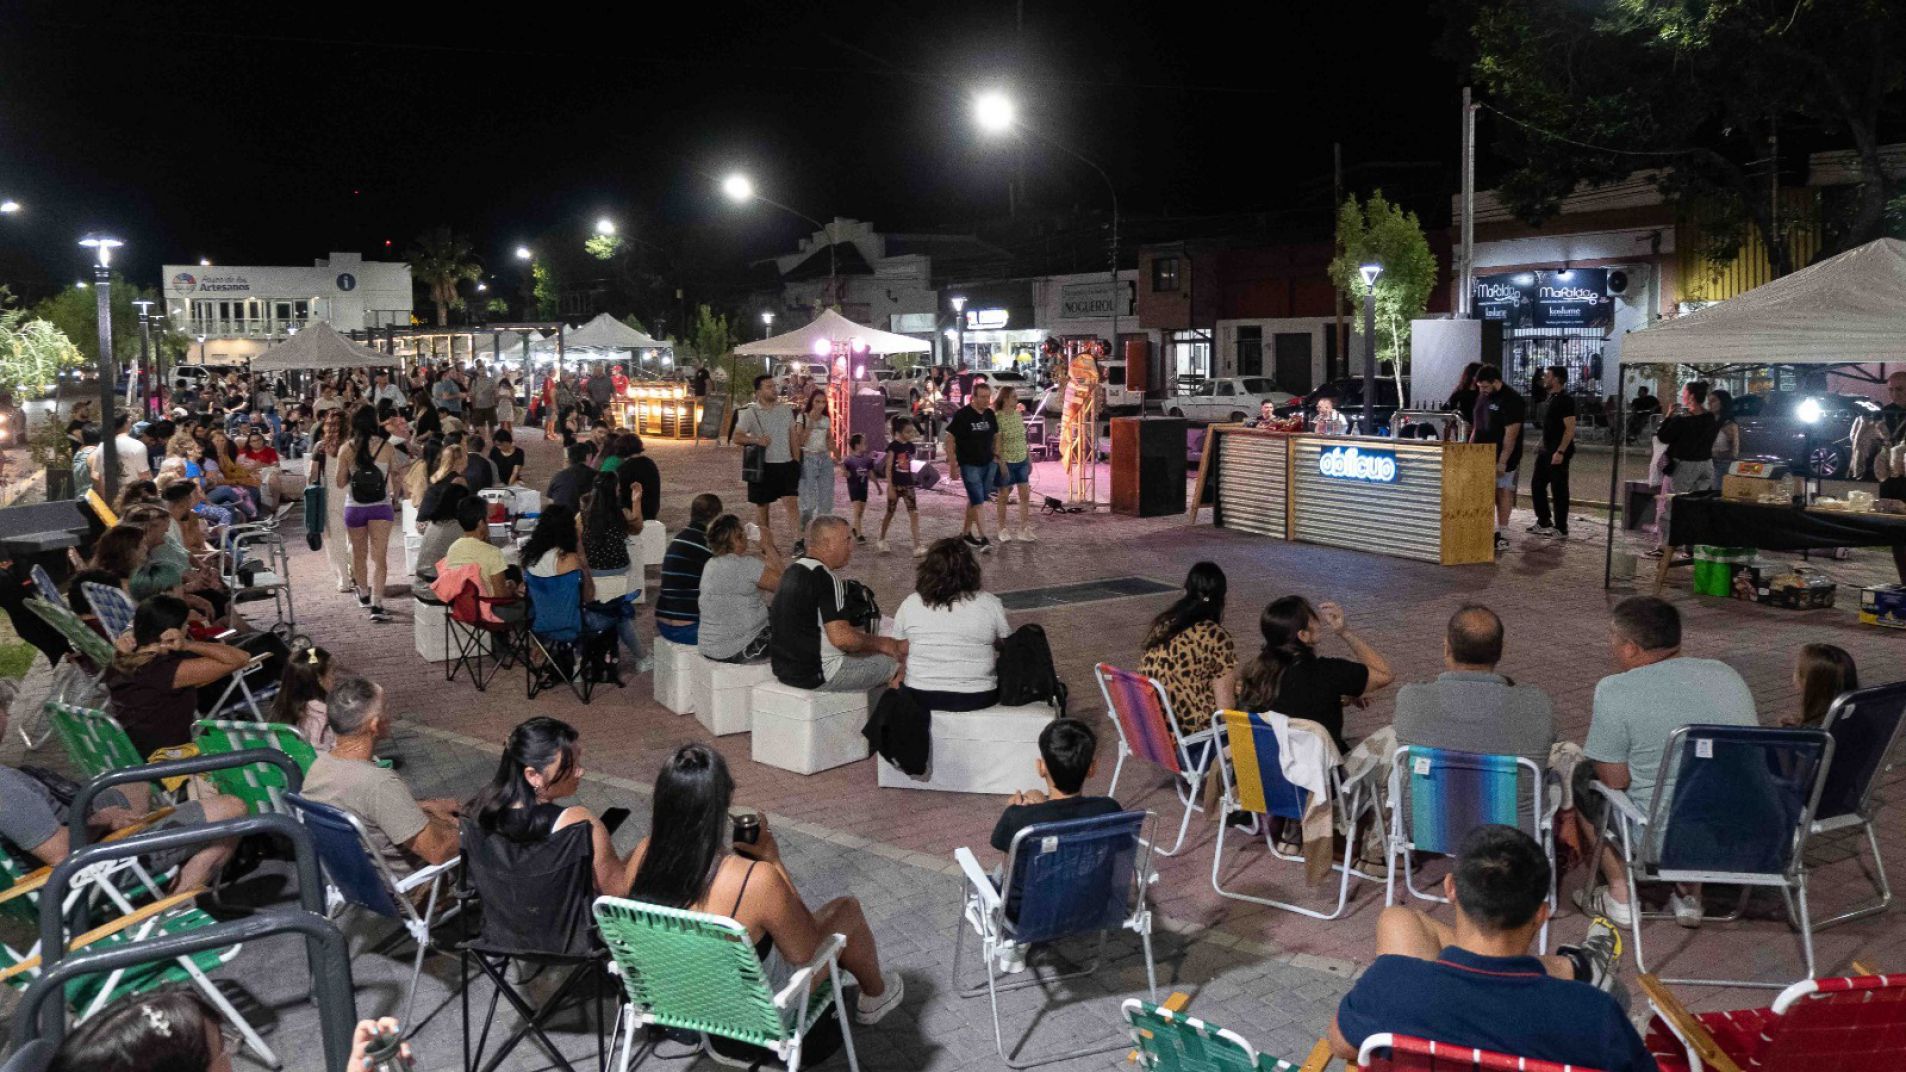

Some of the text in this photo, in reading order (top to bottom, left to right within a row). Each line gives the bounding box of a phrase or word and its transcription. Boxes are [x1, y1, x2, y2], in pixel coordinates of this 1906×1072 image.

[200, 283, 250, 292] Artesanos
[1065, 299, 1115, 313] NOGUEROL
[1320, 446, 1396, 482] oblicuo
